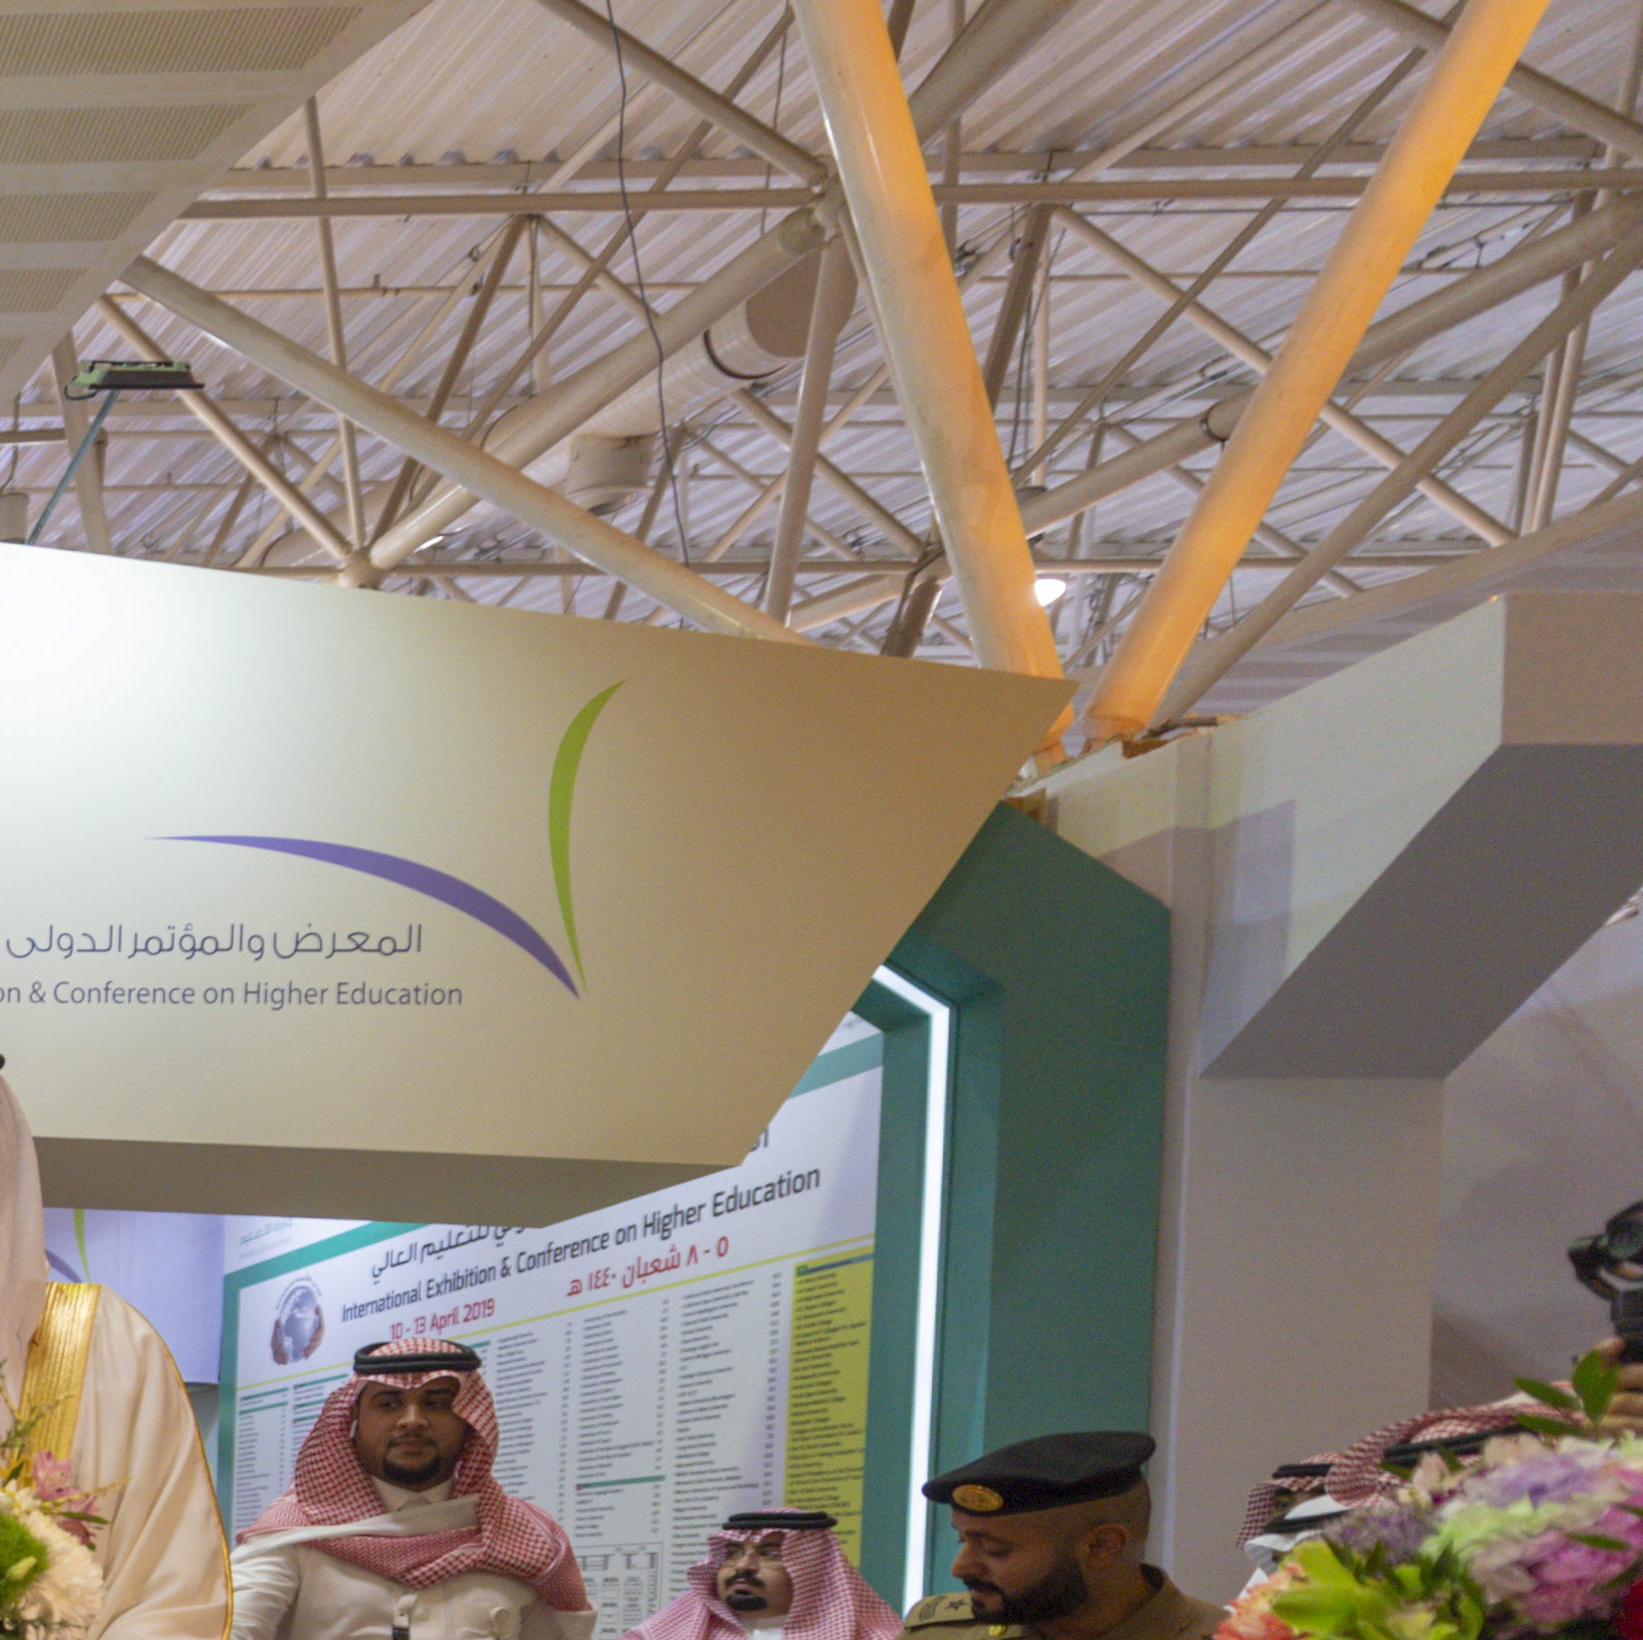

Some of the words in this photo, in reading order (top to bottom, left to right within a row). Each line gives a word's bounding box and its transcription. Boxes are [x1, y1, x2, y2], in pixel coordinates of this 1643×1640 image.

[127, 924, 266, 961] والمؤتمر
[272, 925, 423, 961] المعرض
[28, 984, 46, 1004] &
[52, 981, 197, 1006] Conference
[202, 989, 235, 1006] on
[243, 982, 329, 1010] Higher
[336, 982, 462, 1008] Education
[342, 1284, 422, 1323] International
[426, 1262, 496, 1299] Exhibition
[501, 1256, 512, 1278] &
[517, 1229, 609, 1274] Conference
[615, 1224, 637, 1246] on
[643, 1201, 706, 1241] Higher
[712, 1168, 821, 1218] Education
[390, 1322, 403, 1341] 10
[415, 1317, 427, 1335] 13
[430, 1308, 460, 1338] April
[464, 1297, 495, 1327] 2019
